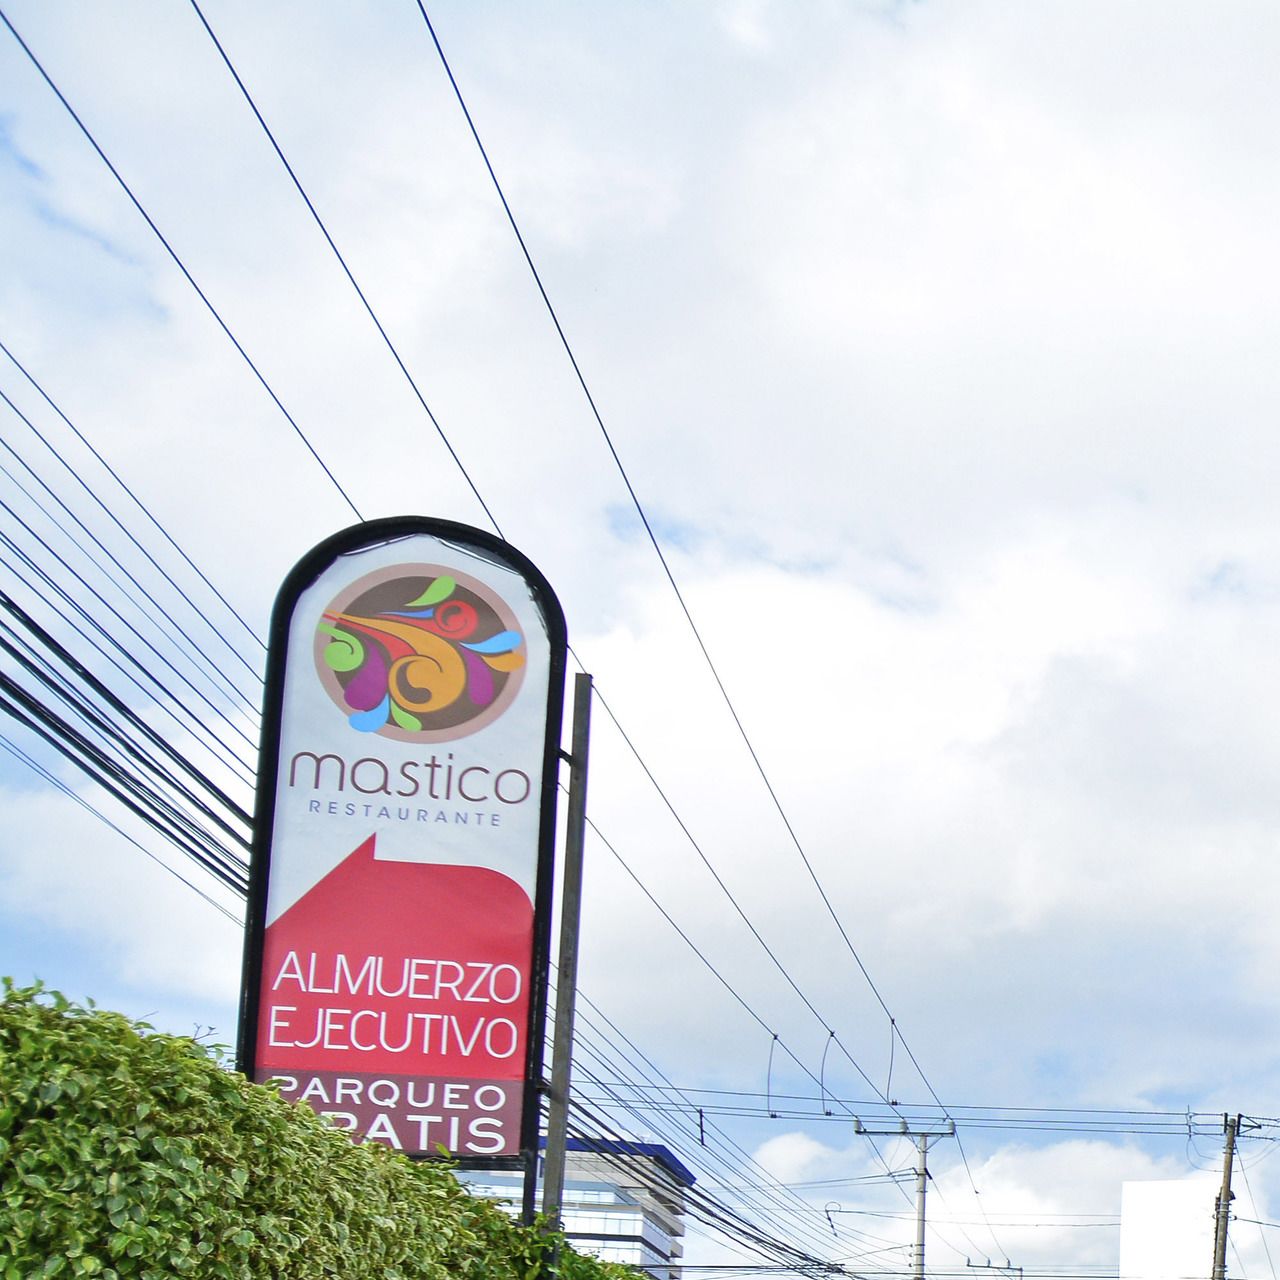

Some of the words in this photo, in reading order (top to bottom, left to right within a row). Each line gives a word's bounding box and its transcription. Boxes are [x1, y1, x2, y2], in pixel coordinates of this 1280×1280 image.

[288, 752, 532, 805] mastico
[308, 800, 501, 827] RESTAURANTE
[272, 951, 522, 1004] ALMUERZO
[268, 1005, 519, 1059] EJECUTIVO
